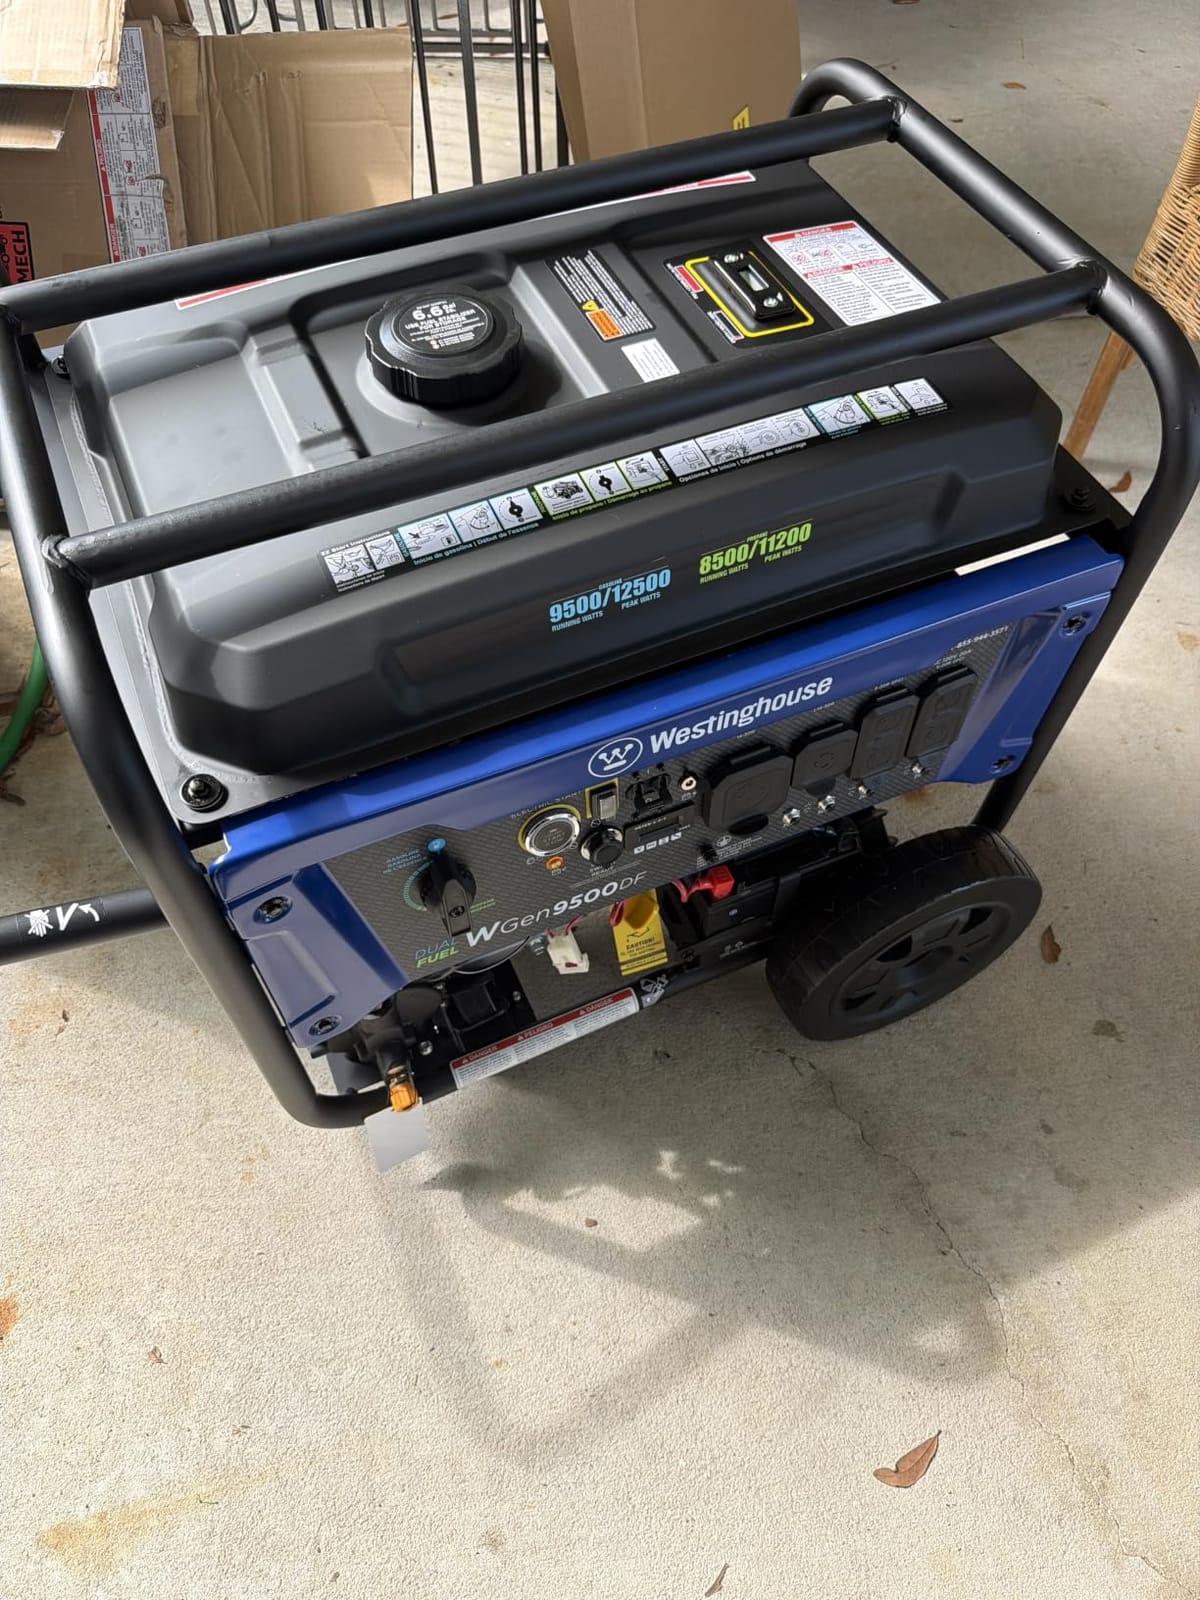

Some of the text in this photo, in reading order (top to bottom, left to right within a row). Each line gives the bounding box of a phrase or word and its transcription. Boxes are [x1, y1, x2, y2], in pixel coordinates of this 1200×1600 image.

[412, 305, 444, 321] 6.6
[699, 522, 812, 575] 8500/11200
[549, 568, 671, 624] 9500/12500
[650, 676, 833, 754] Westinghouse
[466, 870, 647, 947] WGen9500DF
[415, 937, 458, 960] DUAL
[416, 946, 459, 969] FUEL
